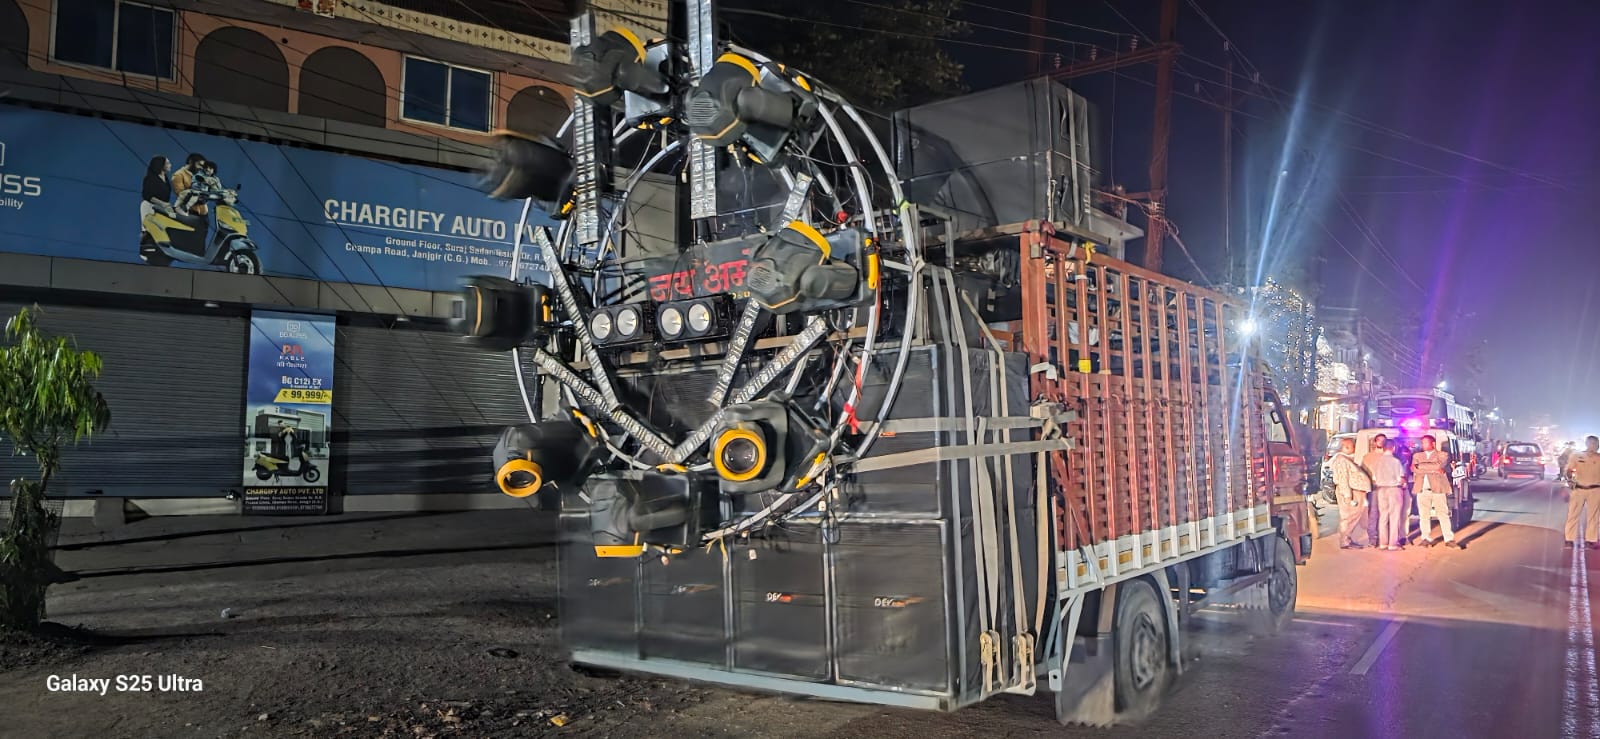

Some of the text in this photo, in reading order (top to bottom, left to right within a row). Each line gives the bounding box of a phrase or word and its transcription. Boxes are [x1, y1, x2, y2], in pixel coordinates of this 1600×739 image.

[324, 199, 446, 232] CHARGIFY
[451, 215, 506, 240] AUTO
[385, 236, 417, 248] Ground
[384, 246, 410, 258] Road,
[411, 250, 442, 262] Janjgir
[443, 254, 469, 265] (C.G.)
[648, 270, 696, 301] जय
[312, 378, 322, 386] EX
